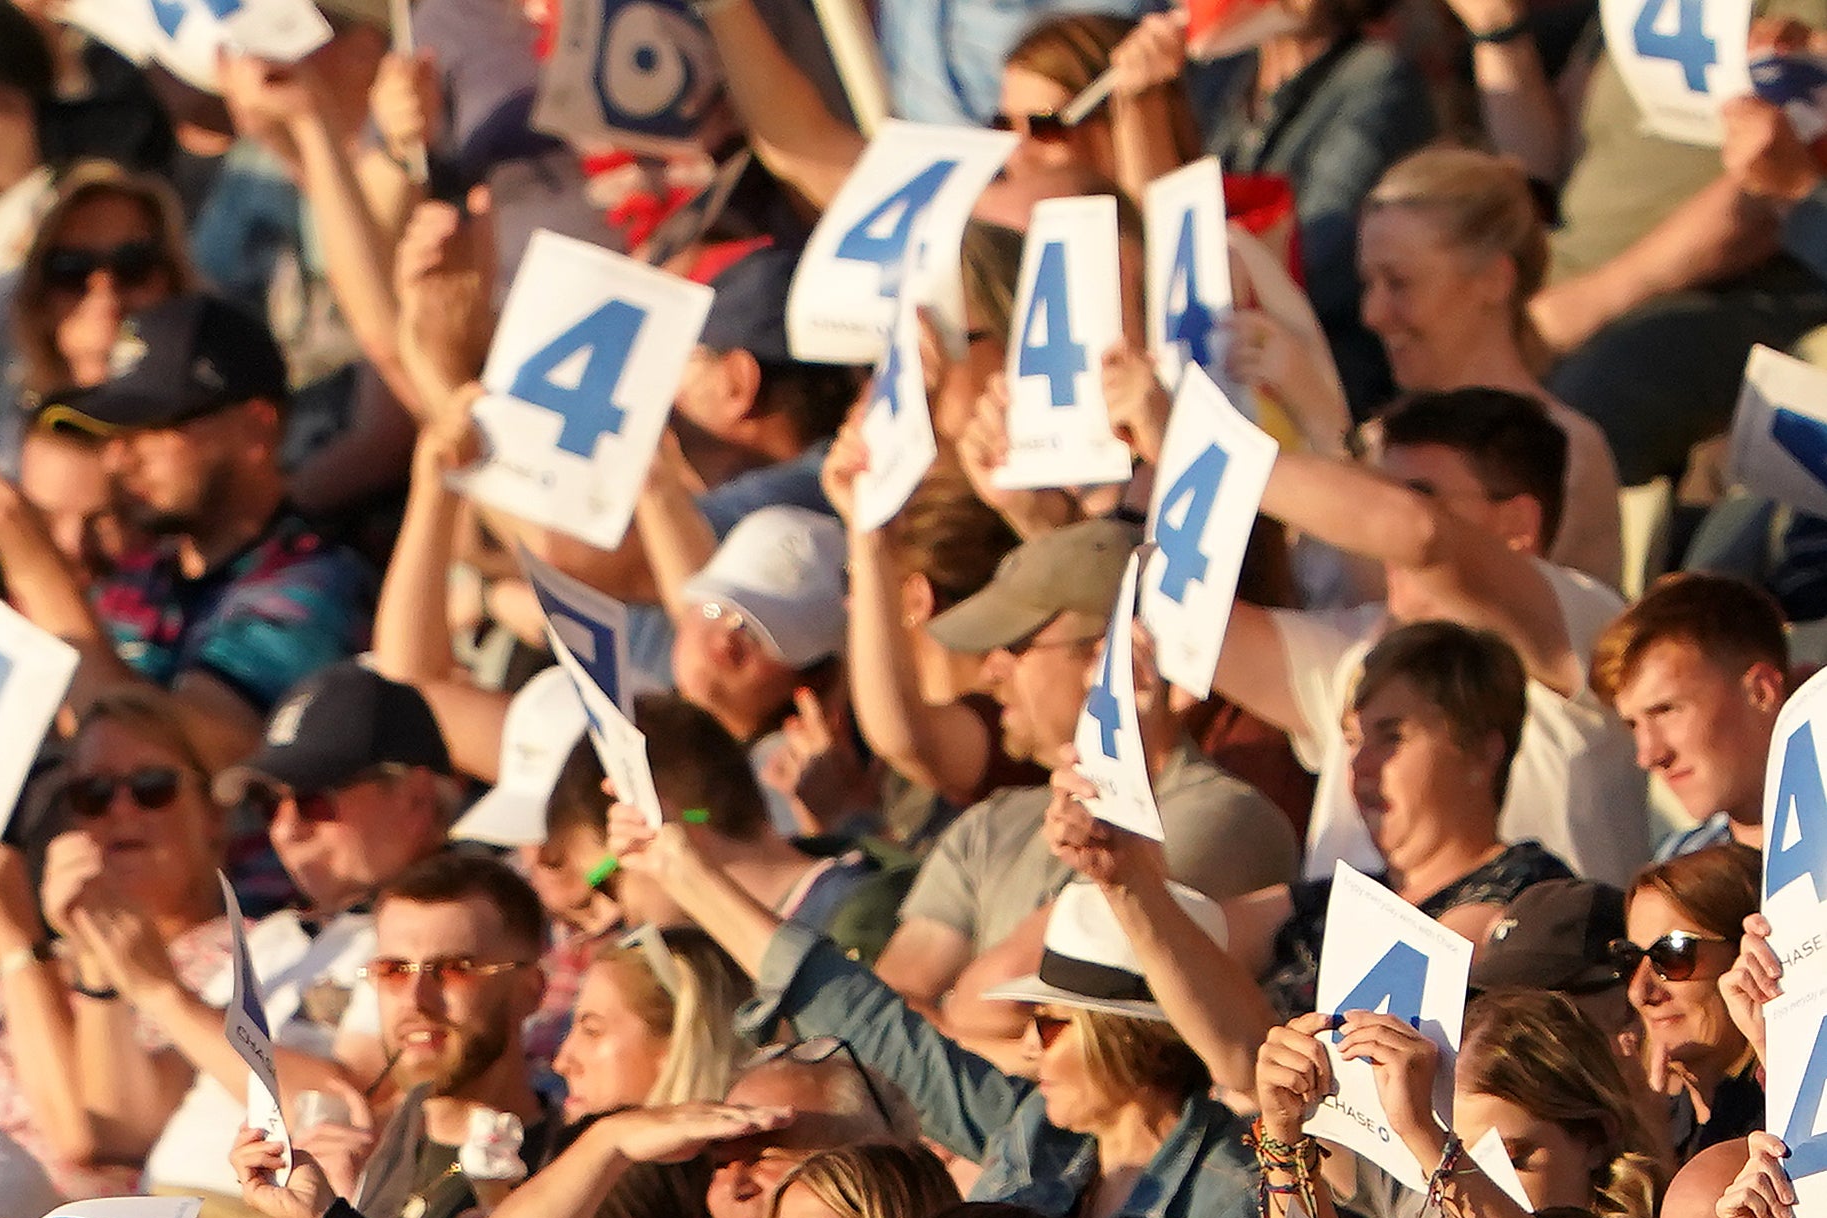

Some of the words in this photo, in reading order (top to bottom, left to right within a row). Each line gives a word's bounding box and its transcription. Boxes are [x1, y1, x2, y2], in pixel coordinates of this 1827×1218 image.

[836, 161, 956, 263] 4
[1166, 211, 1217, 368] 4
[510, 300, 645, 456] 4
[1019, 243, 1084, 406] 4
[1156, 443, 1228, 601] 4
[1779, 933, 1825, 967] HASE
[1322, 1094, 1376, 1136] CHASE
